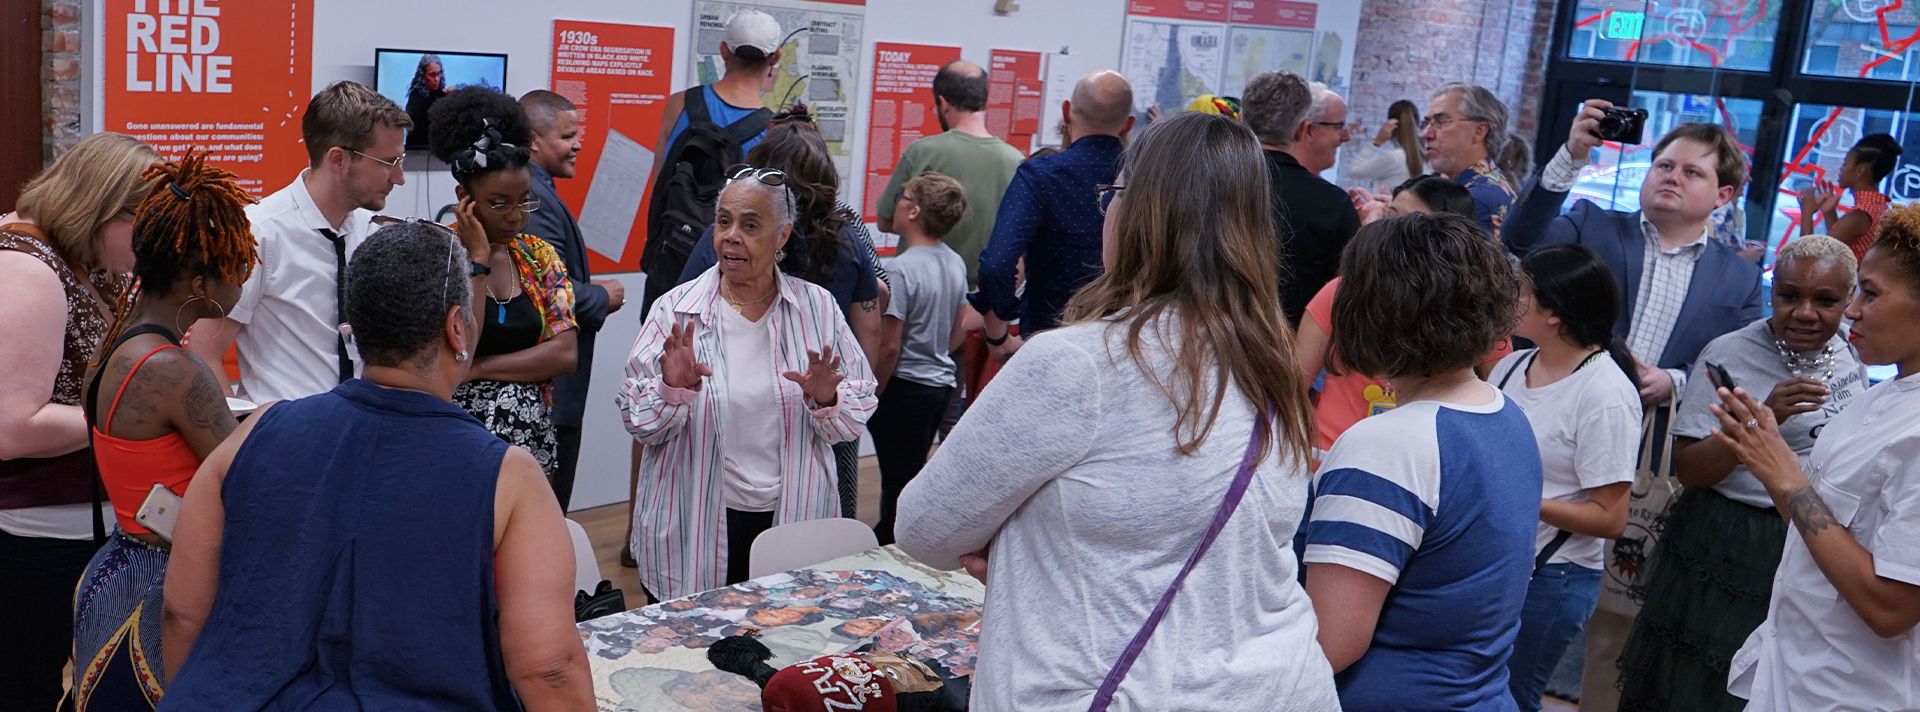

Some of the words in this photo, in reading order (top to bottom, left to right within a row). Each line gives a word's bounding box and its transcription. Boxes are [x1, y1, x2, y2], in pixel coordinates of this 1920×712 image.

[1608, 11, 1645, 39] EXIT
[127, 13, 220, 54] RED
[560, 30, 598, 45] 1930s
[603, 46, 644, 54] SEGREGATION
[879, 50, 912, 63] TODAY
[126, 53, 233, 93] LINE
[126, 122, 148, 130] Gone
[150, 122, 199, 130] unanswered
[216, 122, 264, 130] fundamental
[211, 133, 264, 141] communities:
[172, 144, 185, 153] get
[244, 143, 262, 151] does
[170, 154, 181, 162] for
[238, 153, 264, 162] going?
[1837, 388, 1852, 400] am
